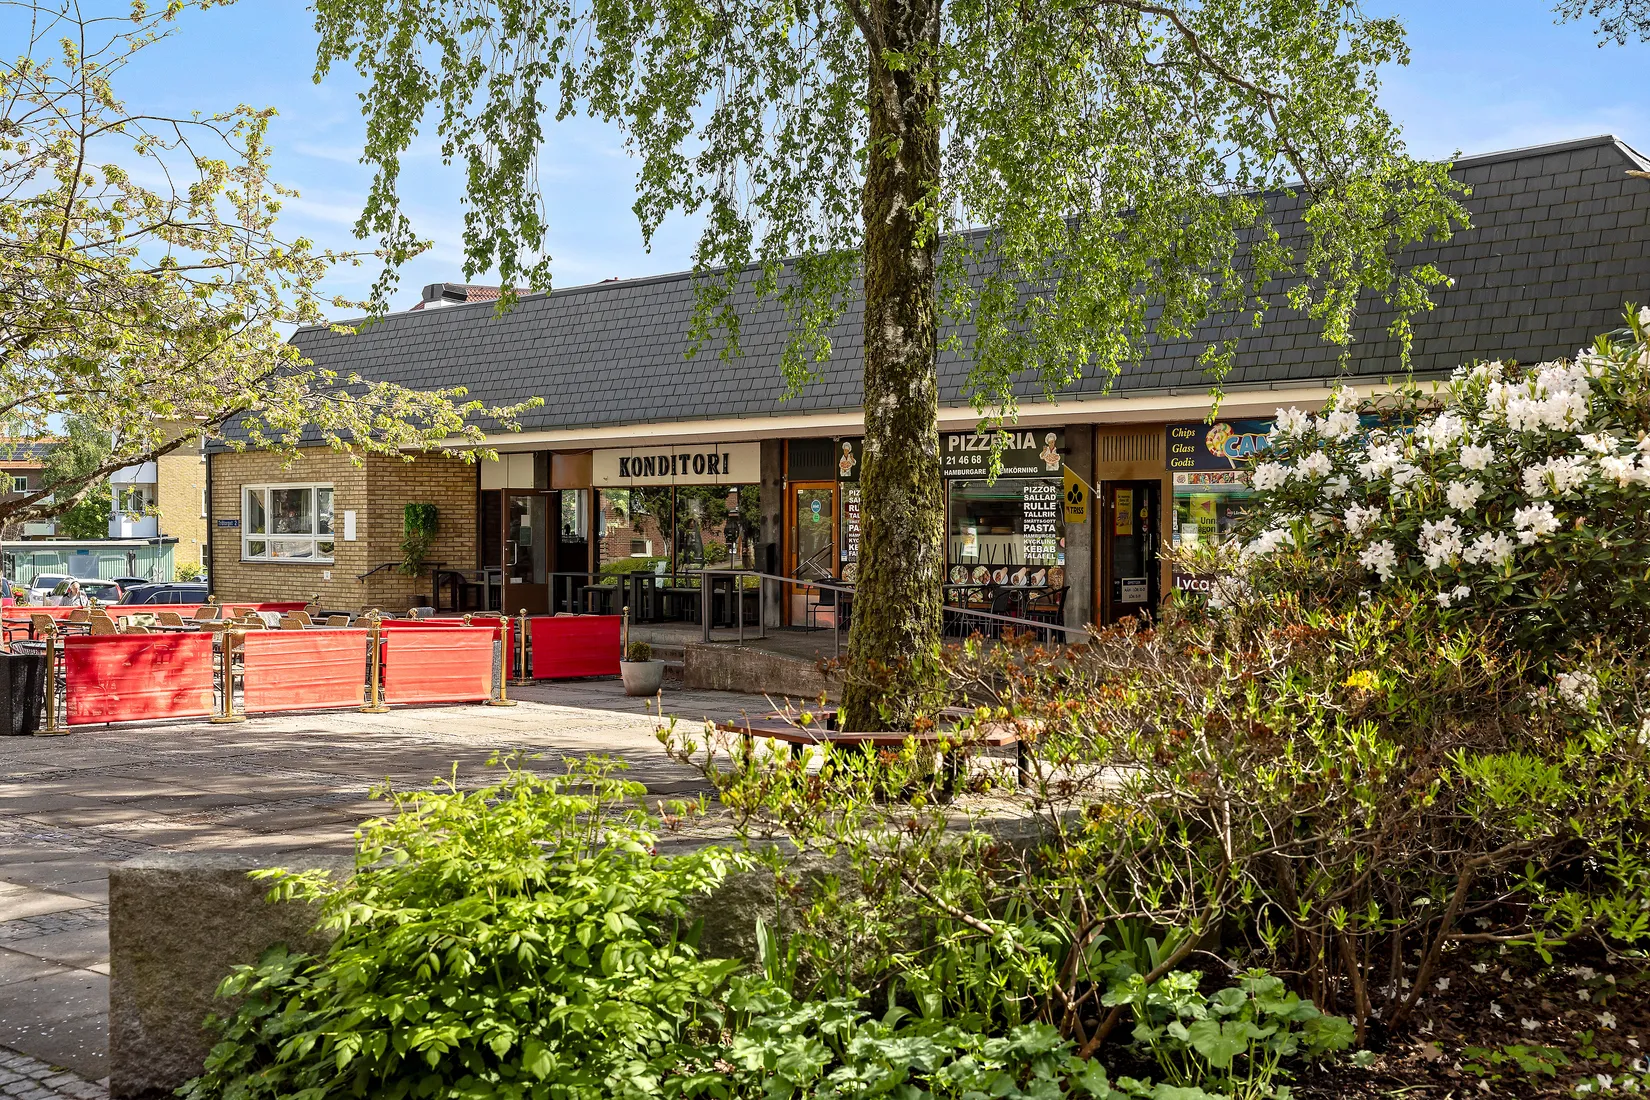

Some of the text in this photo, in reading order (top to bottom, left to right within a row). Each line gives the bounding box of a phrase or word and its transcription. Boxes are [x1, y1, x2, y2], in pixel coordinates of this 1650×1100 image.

[1172, 427, 1196, 438] Chips
[948, 432, 1037, 452] PIZZERIA
[1172, 443, 1195, 453] Glass
[946, 456, 957, 465] 21
[958, 455, 970, 464] 46
[971, 455, 982, 464] 68
[1170, 457, 1195, 467] Godis
[618, 453, 730, 478] KONDITORI
[944, 466, 1039, 476] HAMBURGARE EMKÖRNING
[1023, 502, 1057, 511] RULLE
[1070, 506, 1084, 515] TRISS
[1200, 516, 1216, 525] Unn
[1023, 524, 1056, 532] PASTA
[1023, 545, 1056, 553] KEBAB
